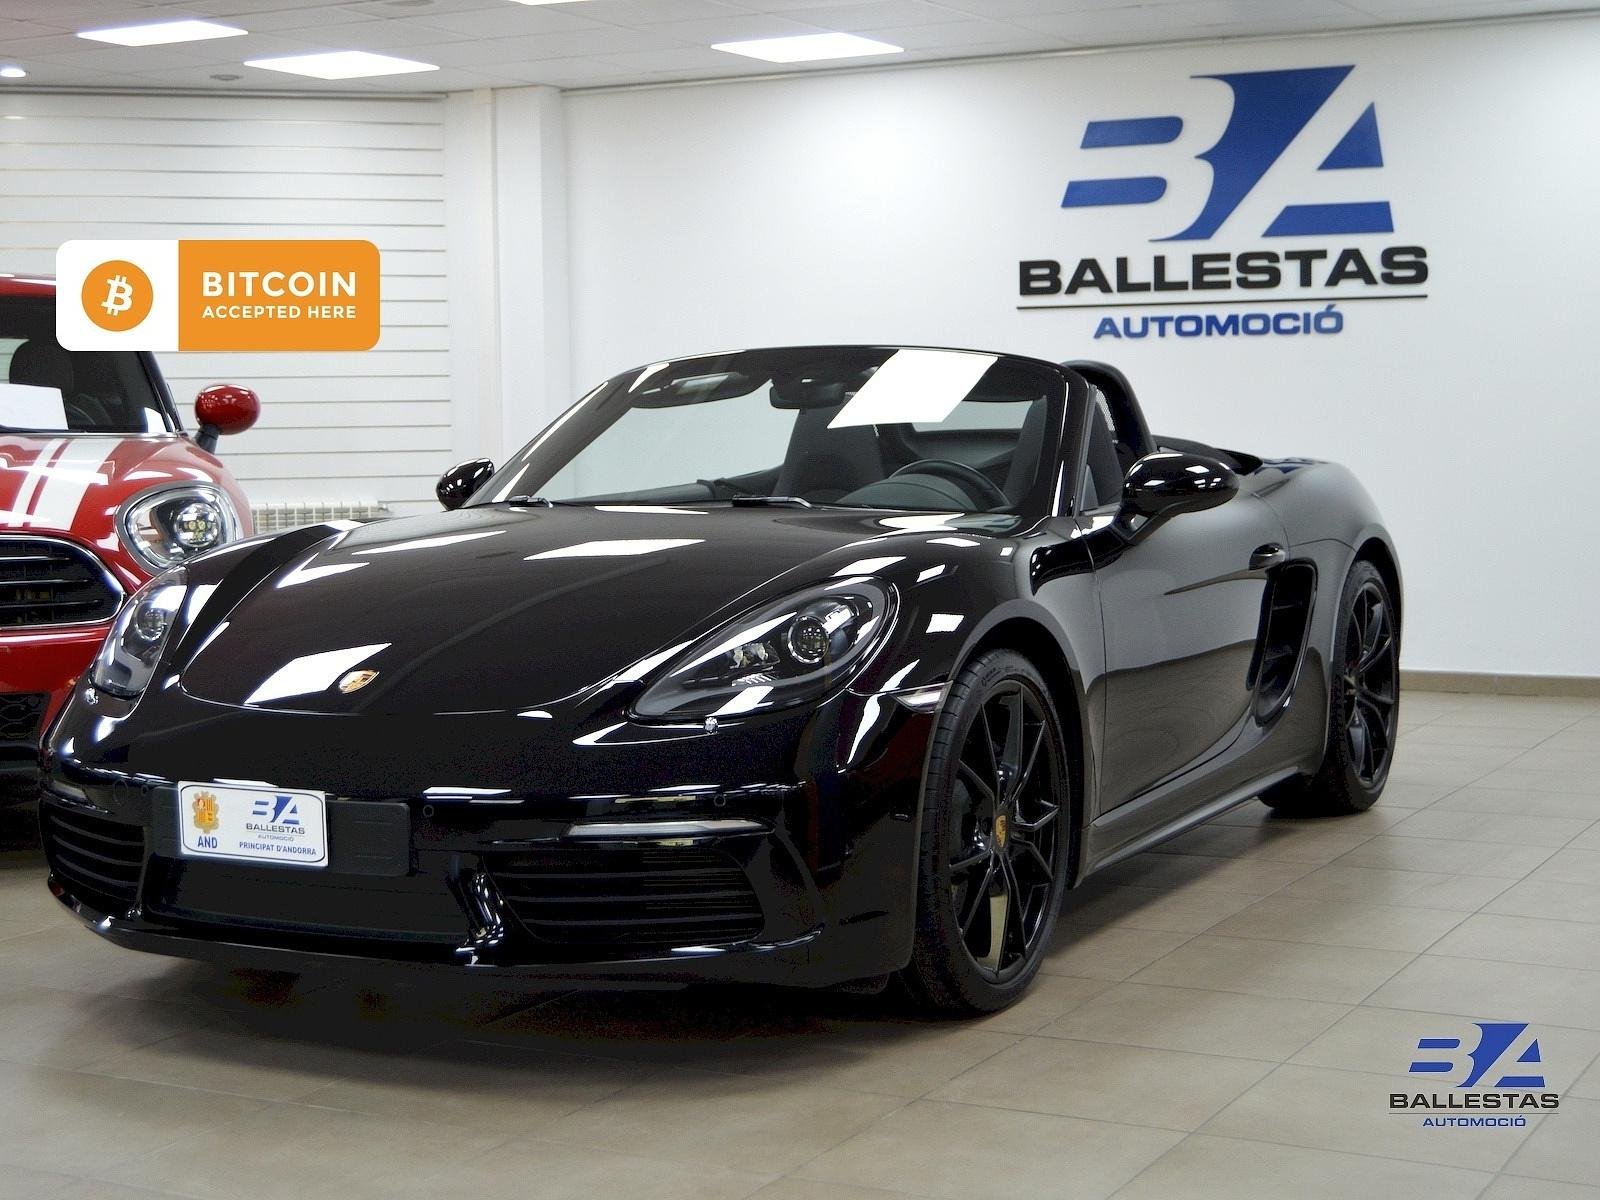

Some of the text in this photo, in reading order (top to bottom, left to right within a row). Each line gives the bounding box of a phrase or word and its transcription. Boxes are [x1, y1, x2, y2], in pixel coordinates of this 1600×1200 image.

[1019, 246, 1429, 296] BALLESTAS
[1093, 304, 1344, 339] AUTOMOCIÓ
[246, 823, 305, 835] BALLESTAS
[197, 836, 218, 849] AND
[239, 841, 317, 855] PRINCIPAT D'ANDORRA
